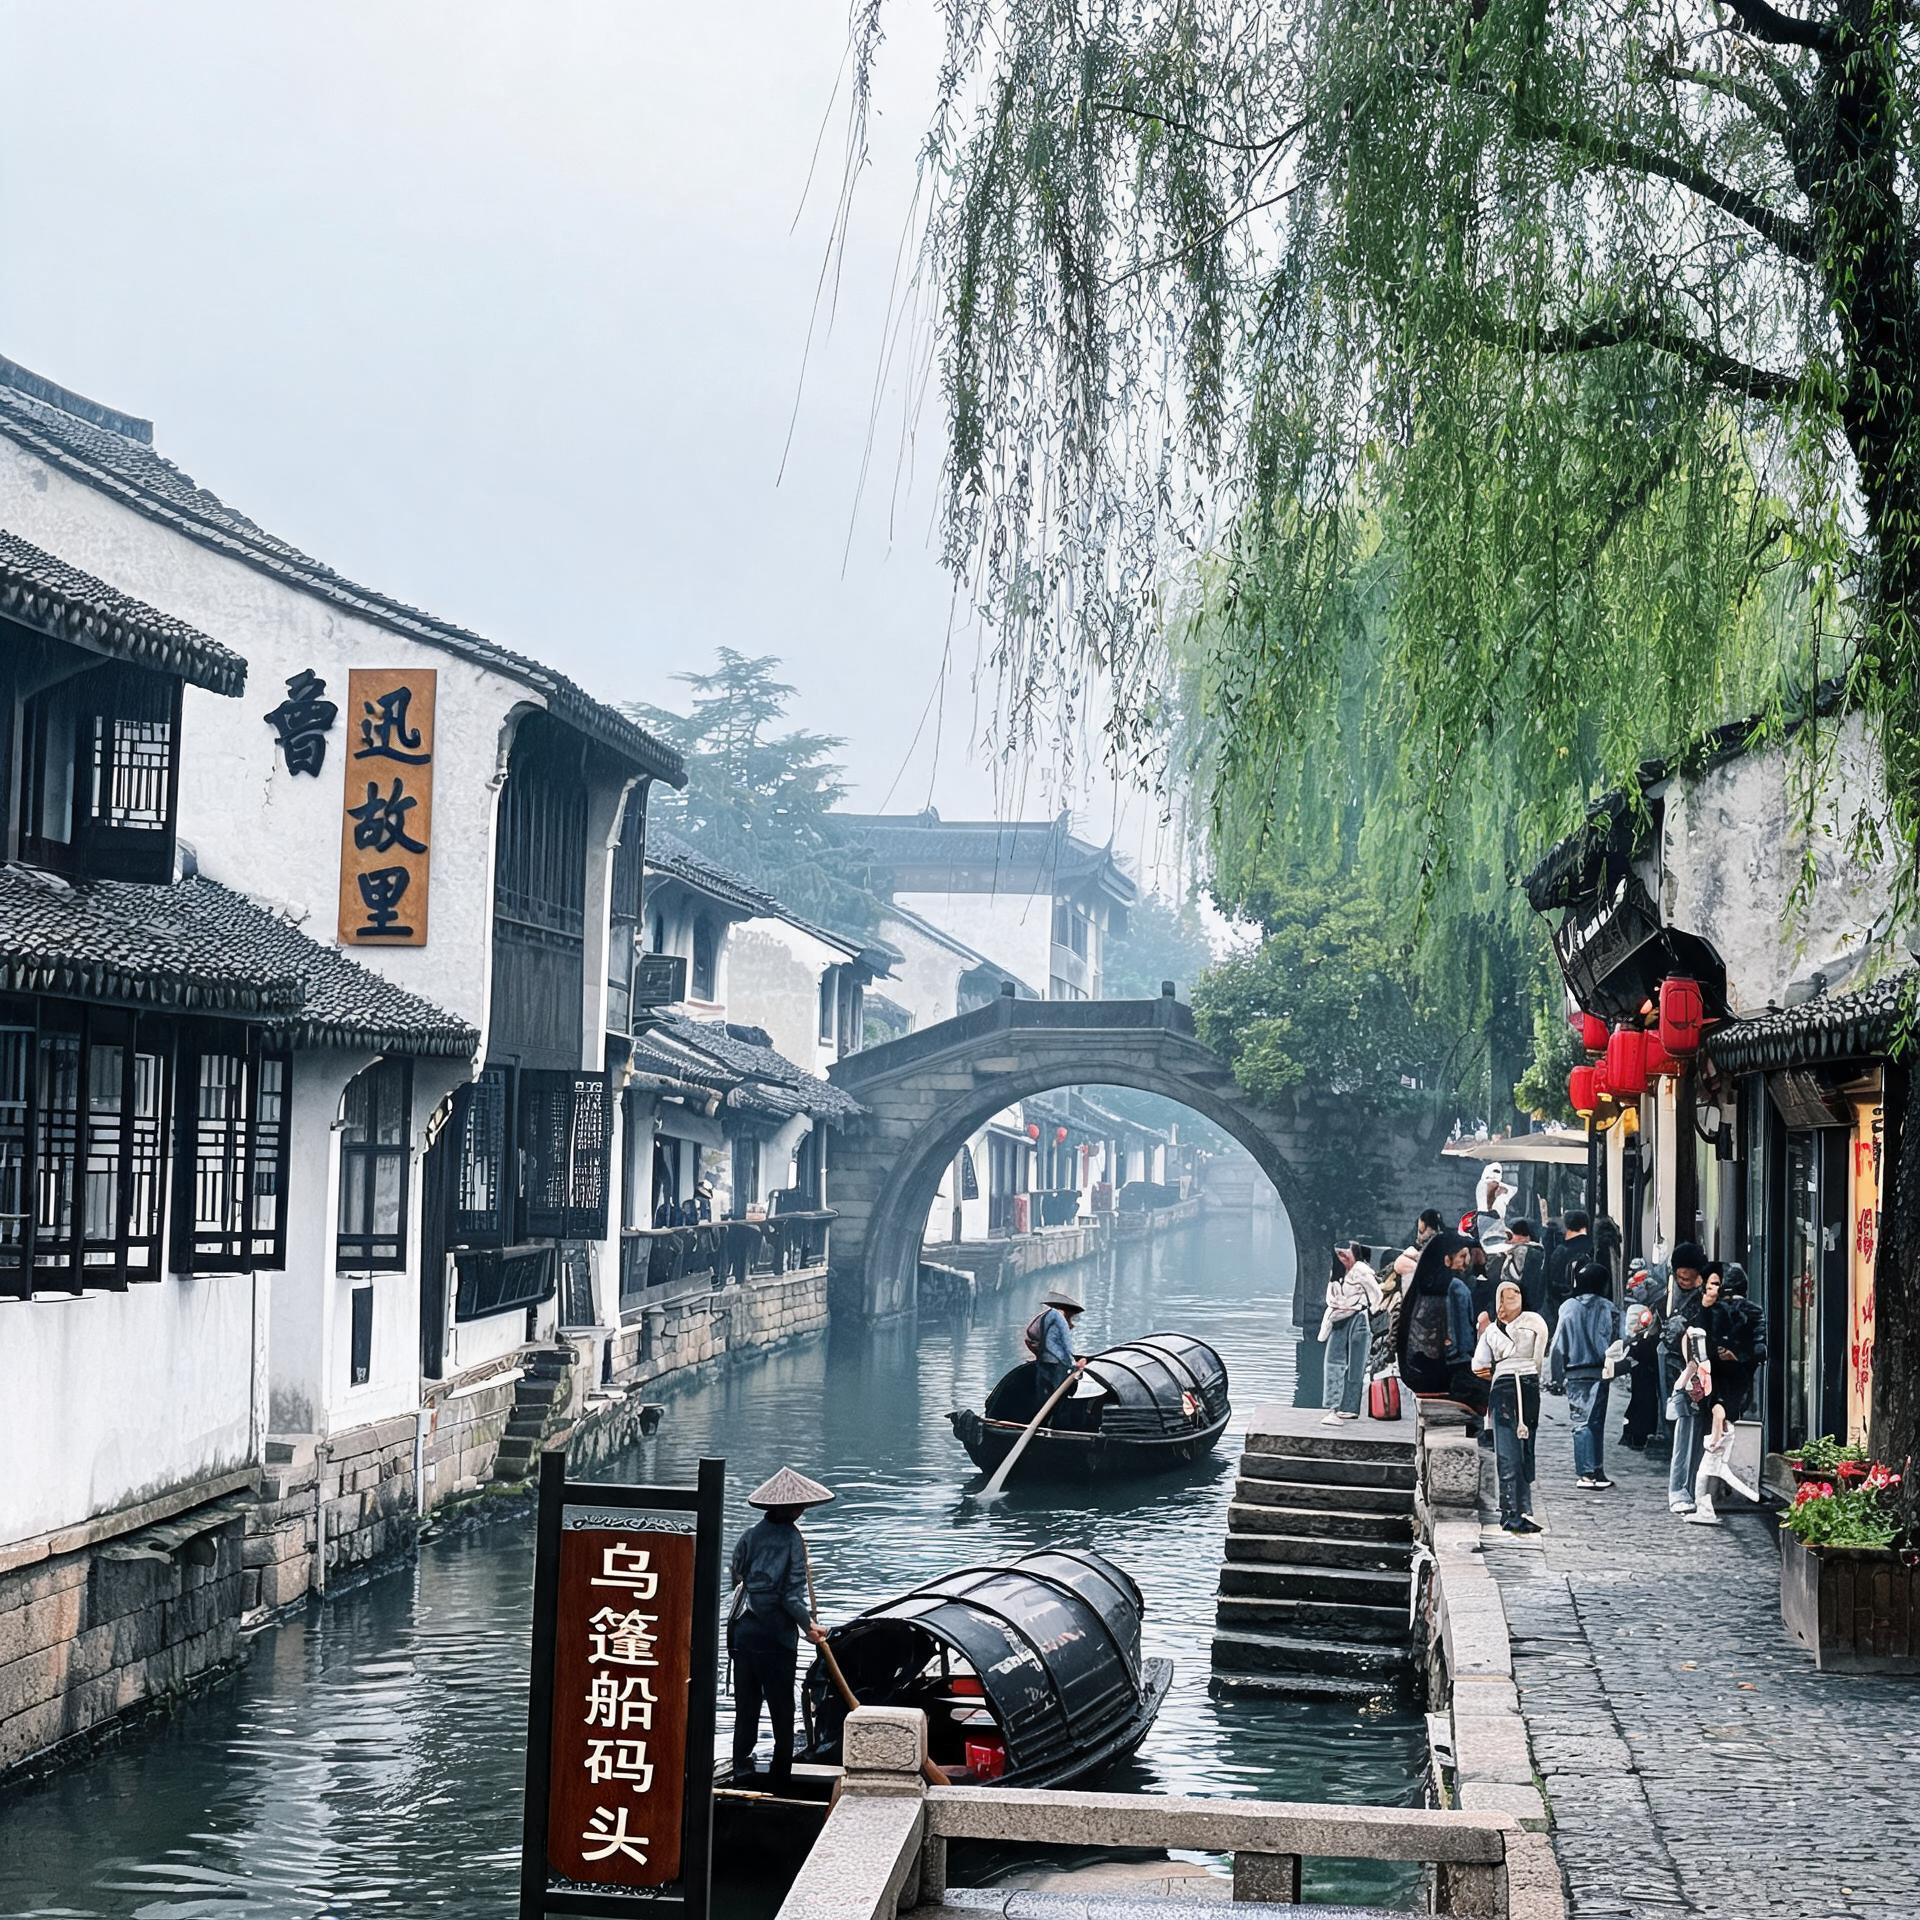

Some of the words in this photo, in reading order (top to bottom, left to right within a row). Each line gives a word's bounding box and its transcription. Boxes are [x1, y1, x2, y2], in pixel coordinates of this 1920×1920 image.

[347, 686, 431, 936] 迅故里
[582, 1542, 660, 1867] 乌篷船码头
